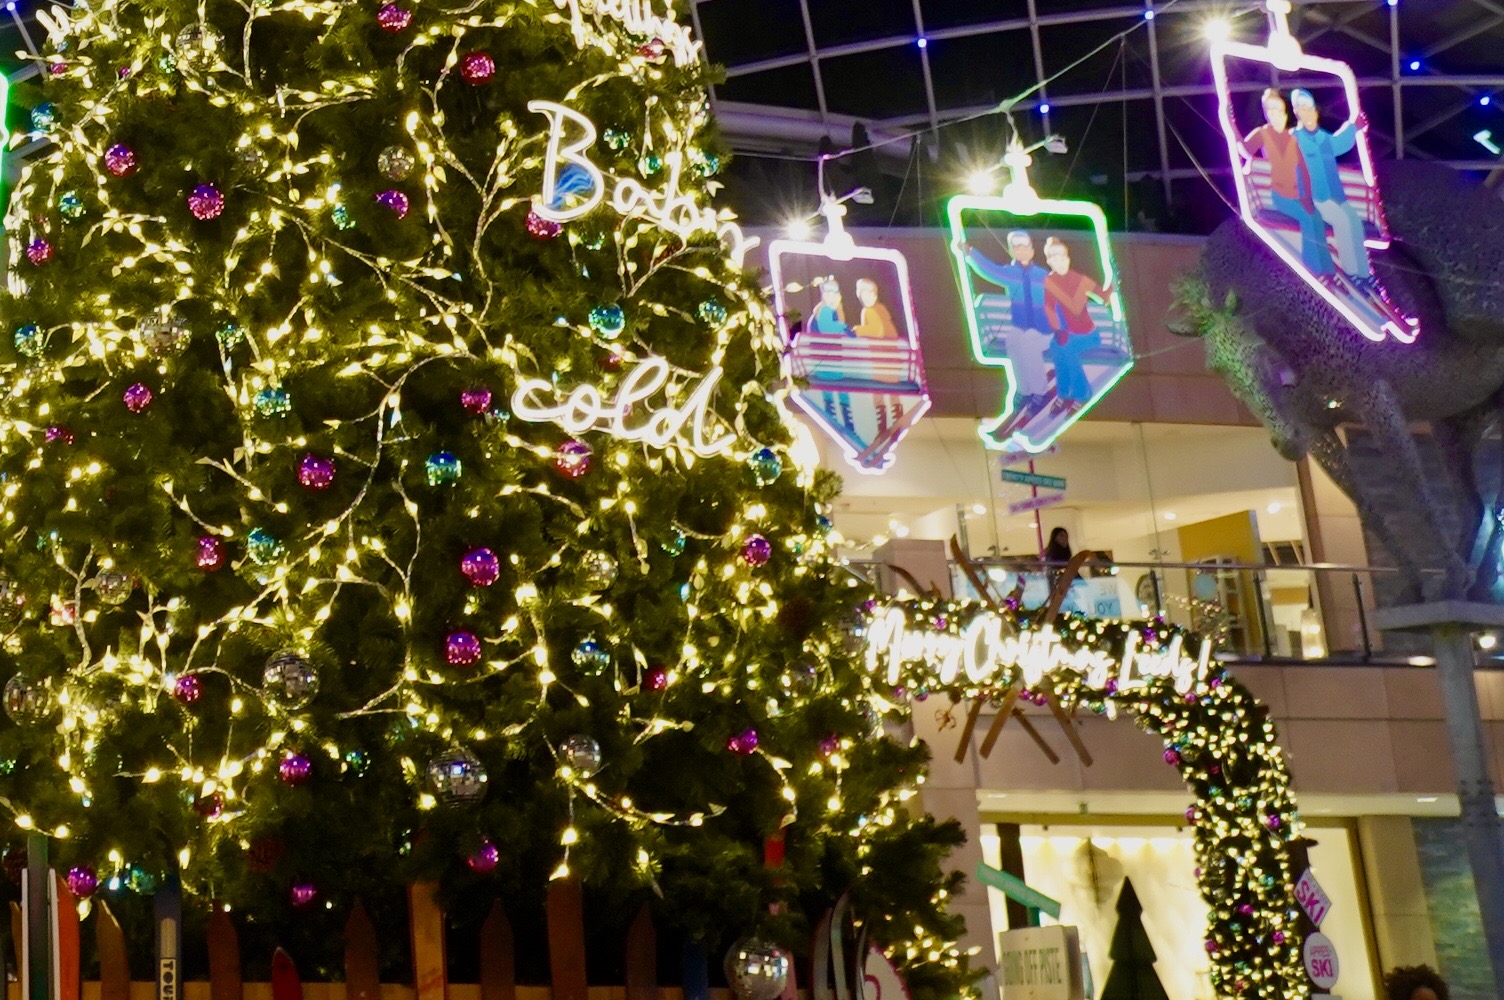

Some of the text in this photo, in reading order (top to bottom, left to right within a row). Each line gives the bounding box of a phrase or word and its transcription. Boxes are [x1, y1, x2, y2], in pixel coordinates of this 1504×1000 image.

[527, 100, 760, 274] Baby
[511, 356, 736, 457] cold
[866, 608, 1212, 695] Merry Christmas Leeds!
[1296, 880, 1325, 922] SKI
[1311, 959, 1334, 978] SKI
